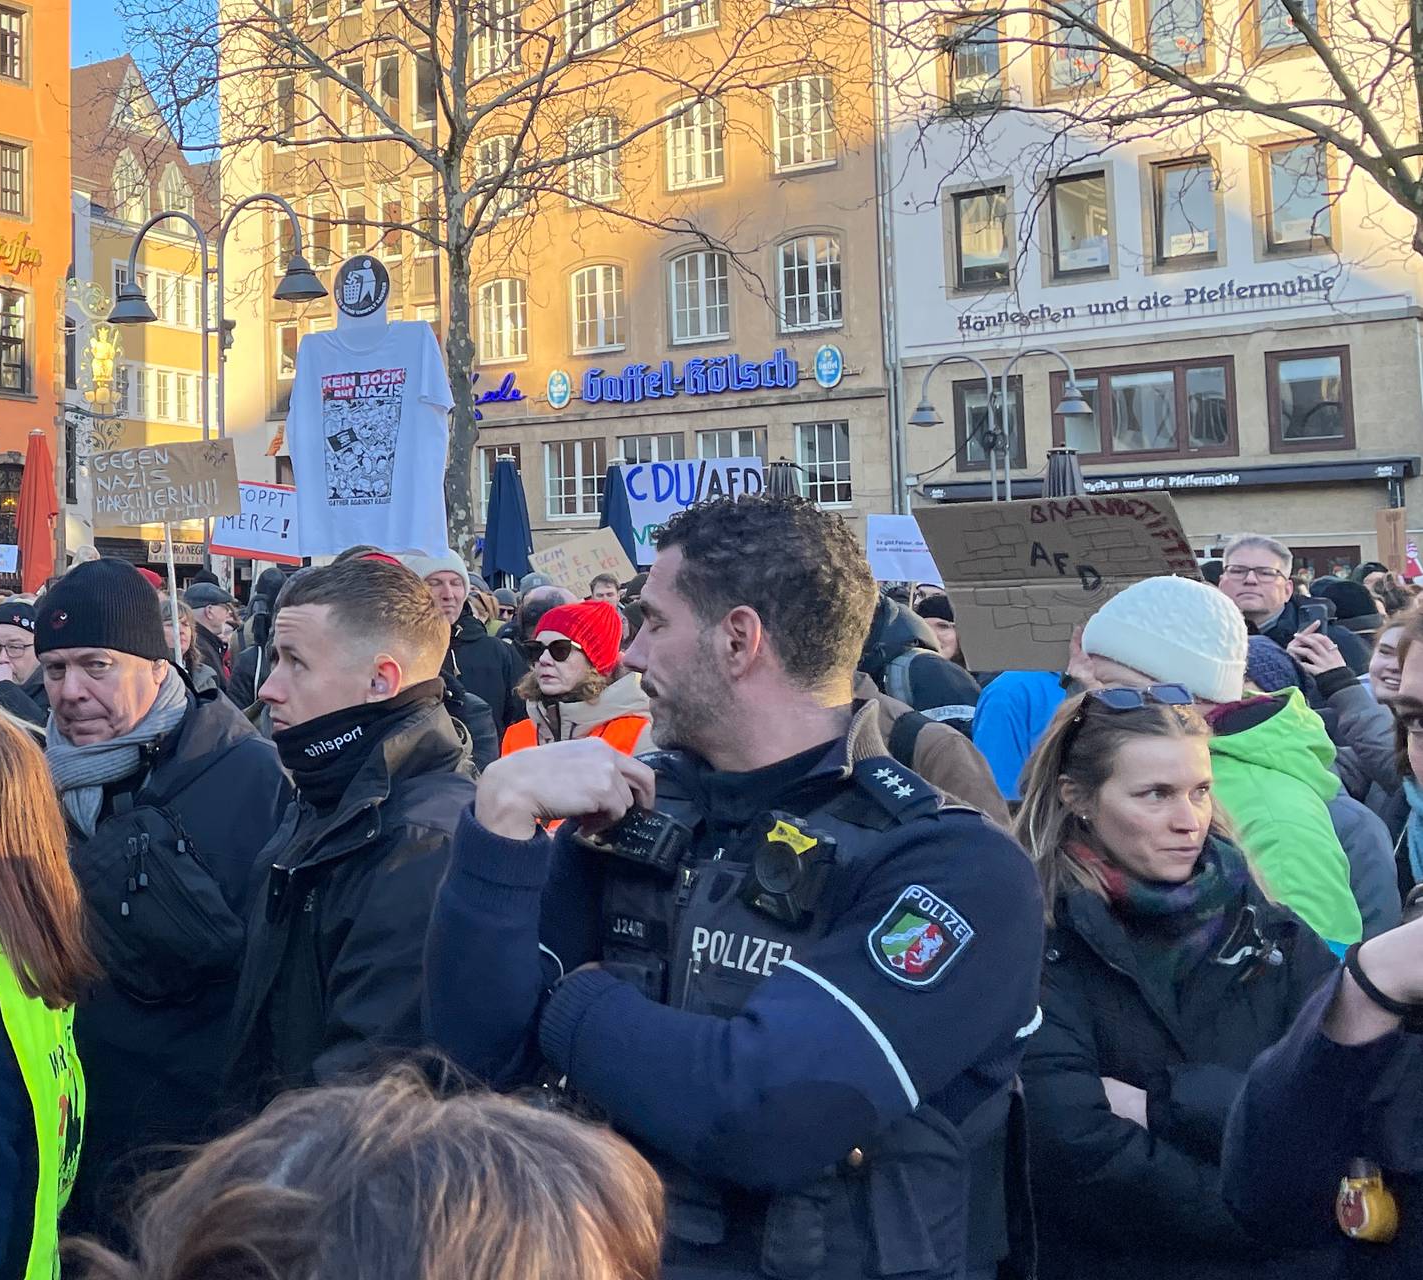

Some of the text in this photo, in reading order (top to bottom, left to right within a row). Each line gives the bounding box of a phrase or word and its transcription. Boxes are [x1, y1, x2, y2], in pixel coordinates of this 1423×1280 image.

[958, 272, 1336, 332] Hänneschen und die Pfeffermühle
[322, 370, 401, 389] KEIN BOCK
[334, 383, 404, 398] auf NAZIS
[93, 448, 170, 473] GEGEN
[96, 466, 172, 492] NAZIS
[1122, 478, 1144, 488] und
[1146, 476, 1164, 489] die
[96, 478, 219, 513] MARSCHIERN!!!
[239, 486, 291, 509] TOPPT
[221, 513, 291, 540] MERZ!
[304, 725, 364, 758] uhlsport
[905, 886, 971, 944] POLIZEI
